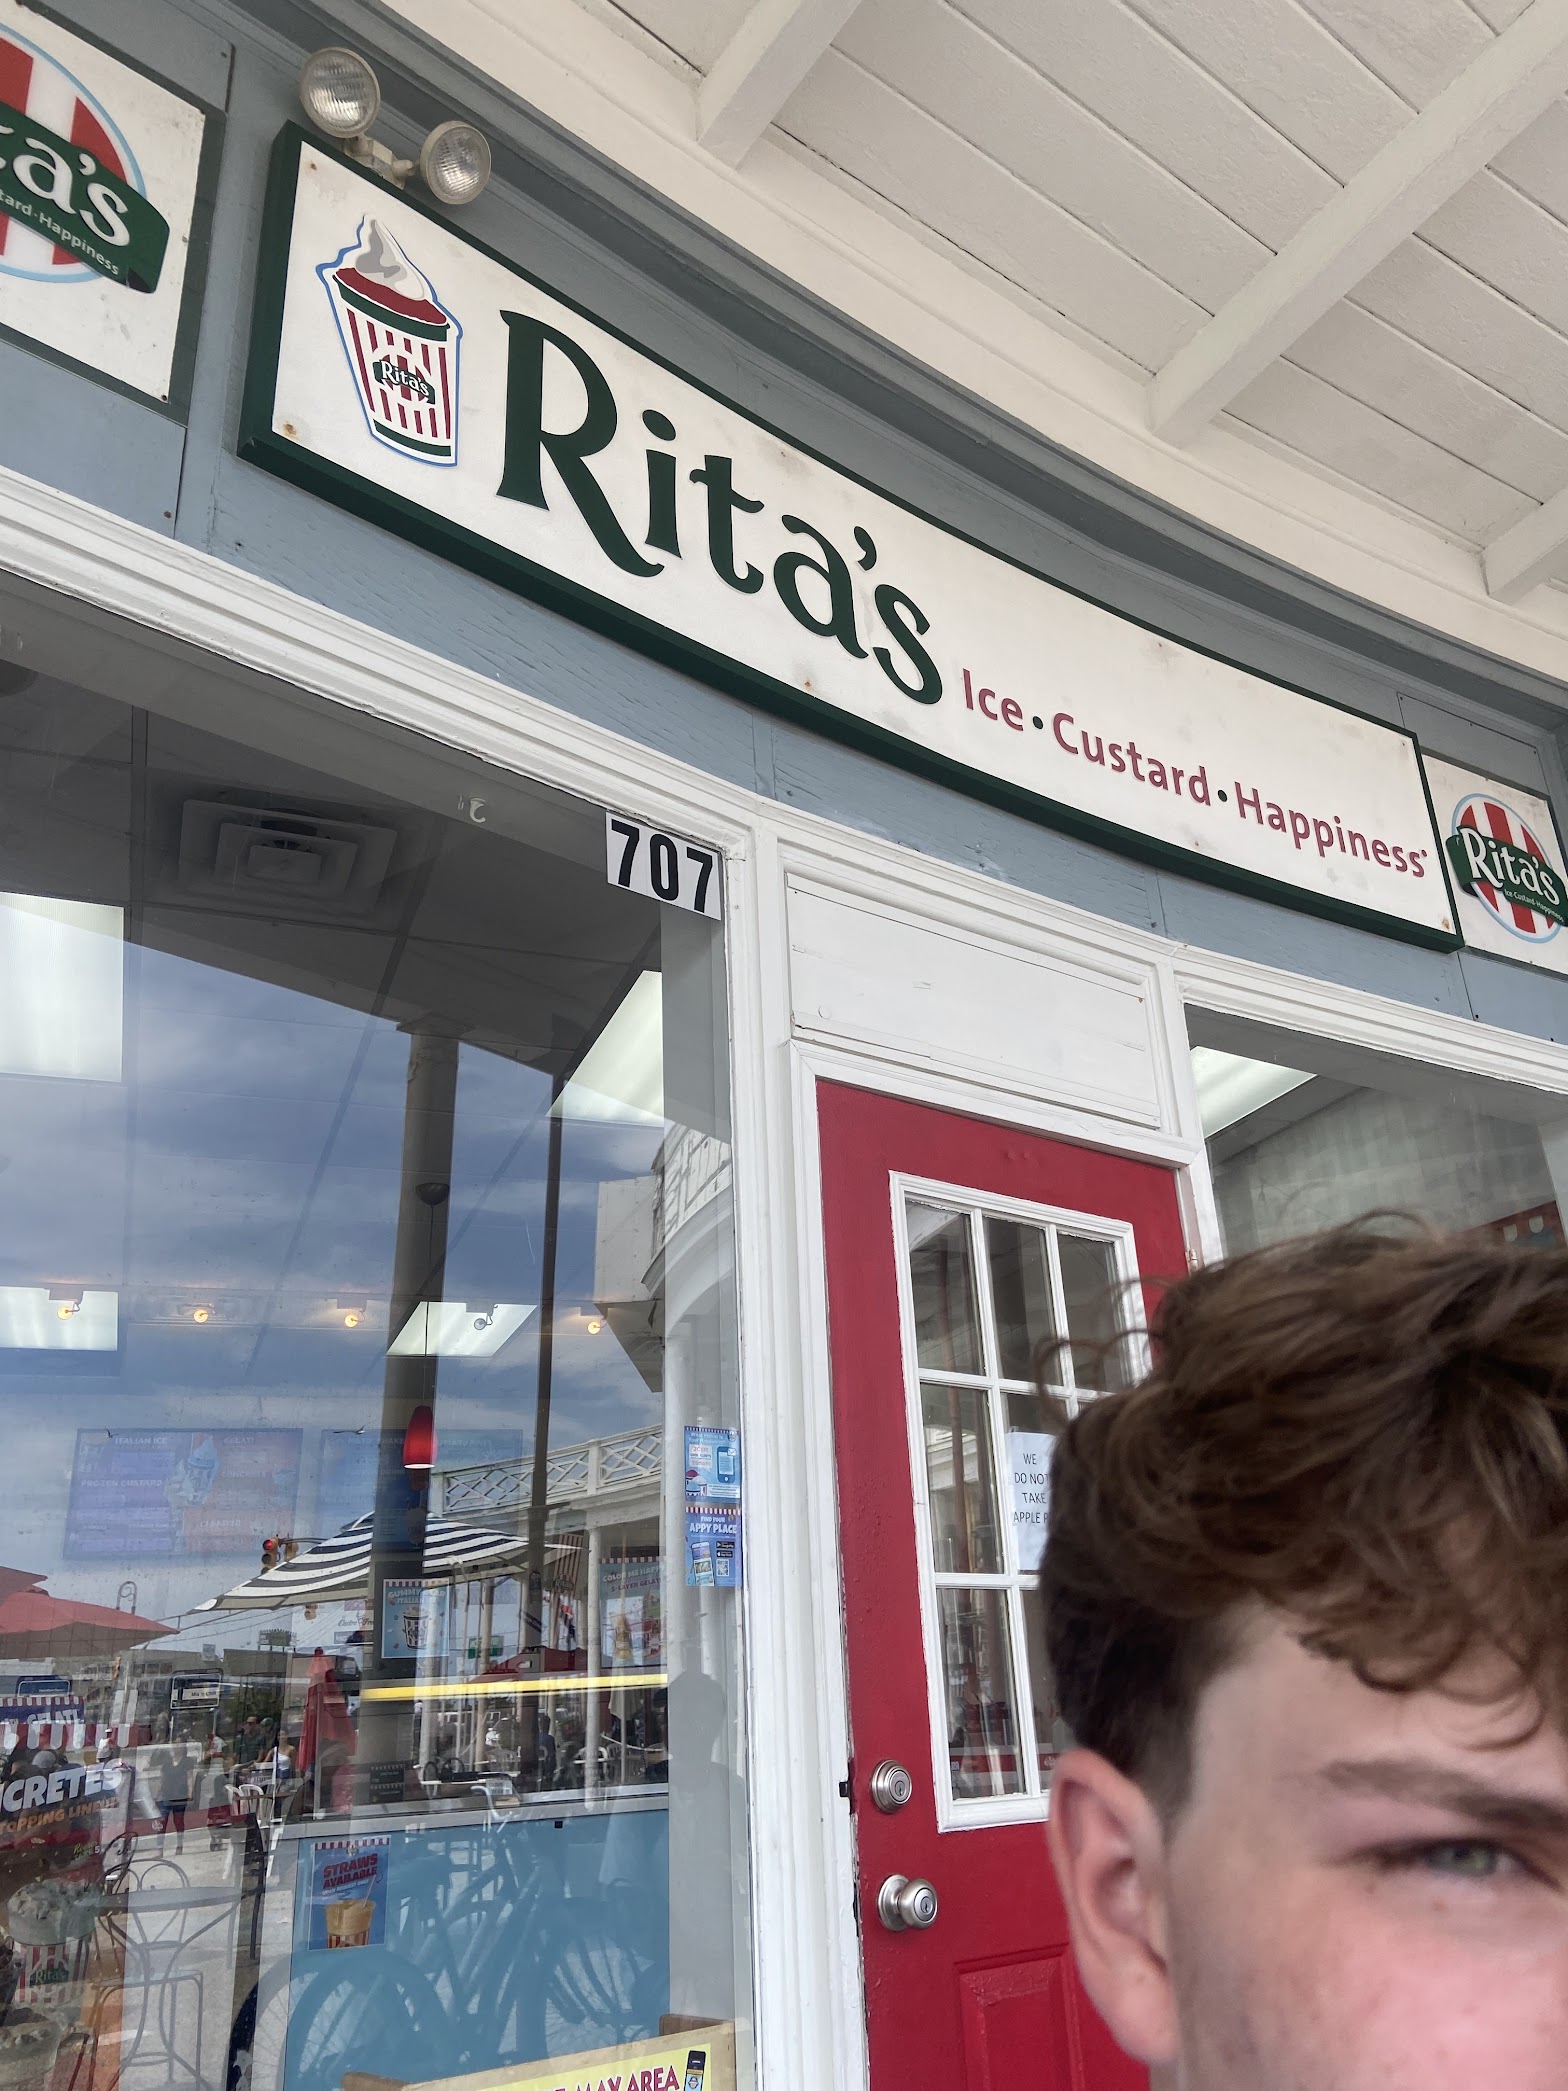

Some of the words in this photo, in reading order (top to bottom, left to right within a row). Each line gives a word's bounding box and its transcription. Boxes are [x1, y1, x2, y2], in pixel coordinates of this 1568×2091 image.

[39, 212, 119, 276] Happiness
[381, 360, 430, 396] Rita's
[496, 309, 943, 705] Rita's
[963, 669, 1025, 731] Ice
[1053, 712, 1211, 806] Custard
[611, 818, 713, 913] 707
[1459, 827, 1560, 905] Rita's
[1023, 1453, 1037, 1465] WE
[1014, 1472, 1027, 1484] DO
[1021, 1492, 1047, 1504] TAKE
[690, 1523, 712, 1533] APPY
[713, 1524, 737, 1534] PLACE
[1013, 1511, 1041, 1524] APPLE
[640, 1577, 661, 1587] GELAT
[323, 1853, 378, 1878] STRAWS
[323, 1866, 377, 1889] AVAILABLE
[627, 2065, 680, 2091] AREA
